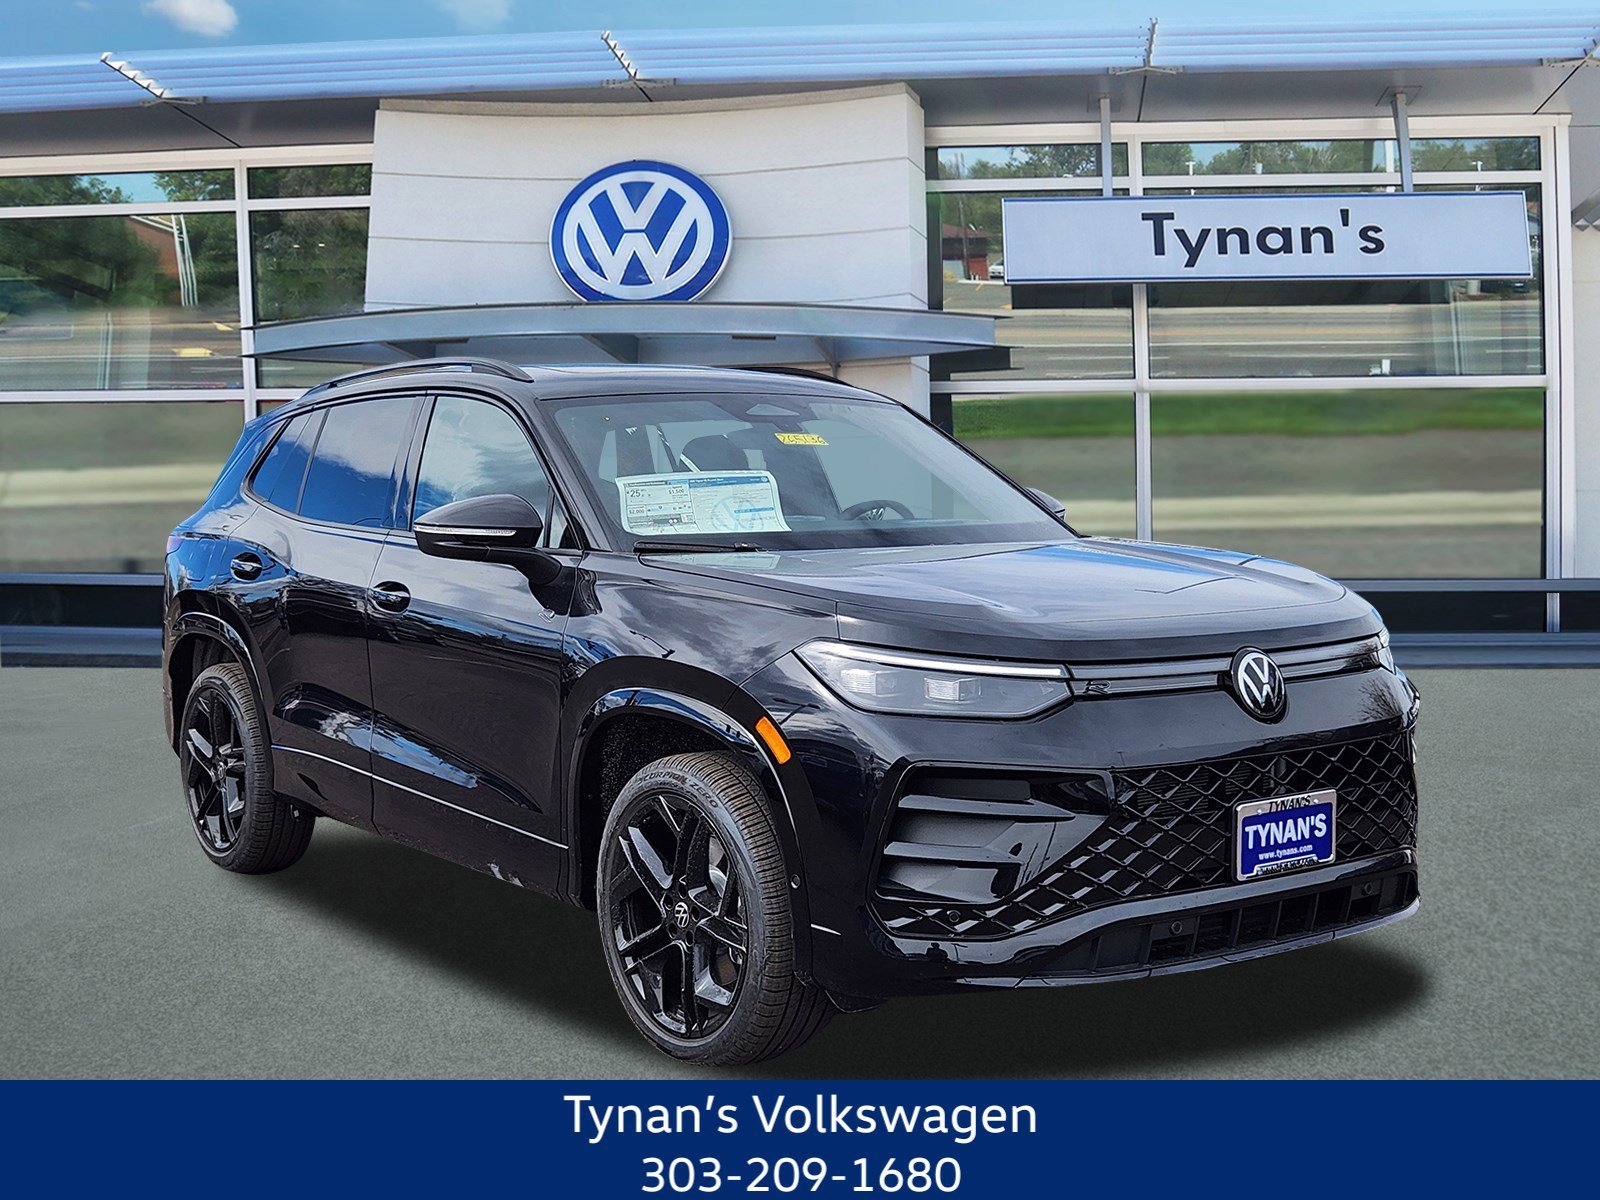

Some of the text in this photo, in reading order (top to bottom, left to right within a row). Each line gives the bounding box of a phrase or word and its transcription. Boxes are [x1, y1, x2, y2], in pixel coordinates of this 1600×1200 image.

[1141, 208, 1386, 268] Tynan's
[688, 781, 719, 808] ZERO
[1244, 813, 1327, 849] TYNAN'S
[1258, 844, 1313, 860] www.tynans.com
